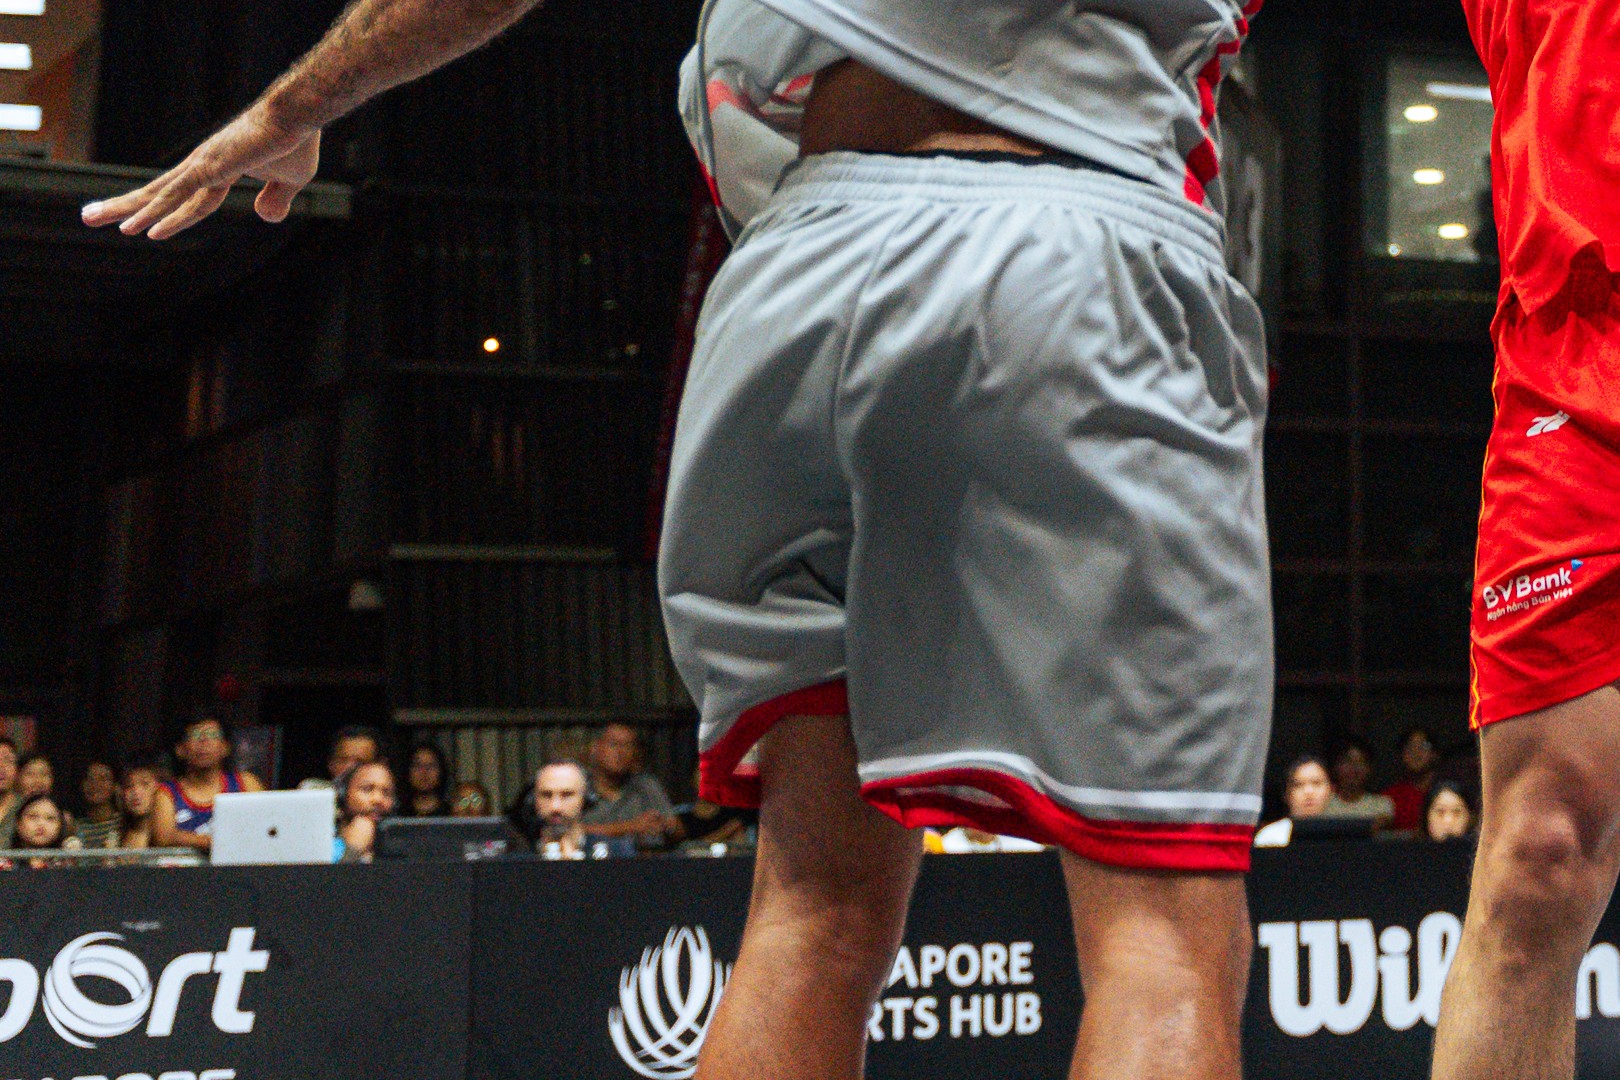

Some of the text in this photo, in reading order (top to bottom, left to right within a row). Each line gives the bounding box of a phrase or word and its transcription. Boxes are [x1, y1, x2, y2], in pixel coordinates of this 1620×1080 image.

[1483, 567, 1572, 609] BVBank
[886, 941, 1035, 989] APORE
[950, 991, 1043, 1038] HUB
